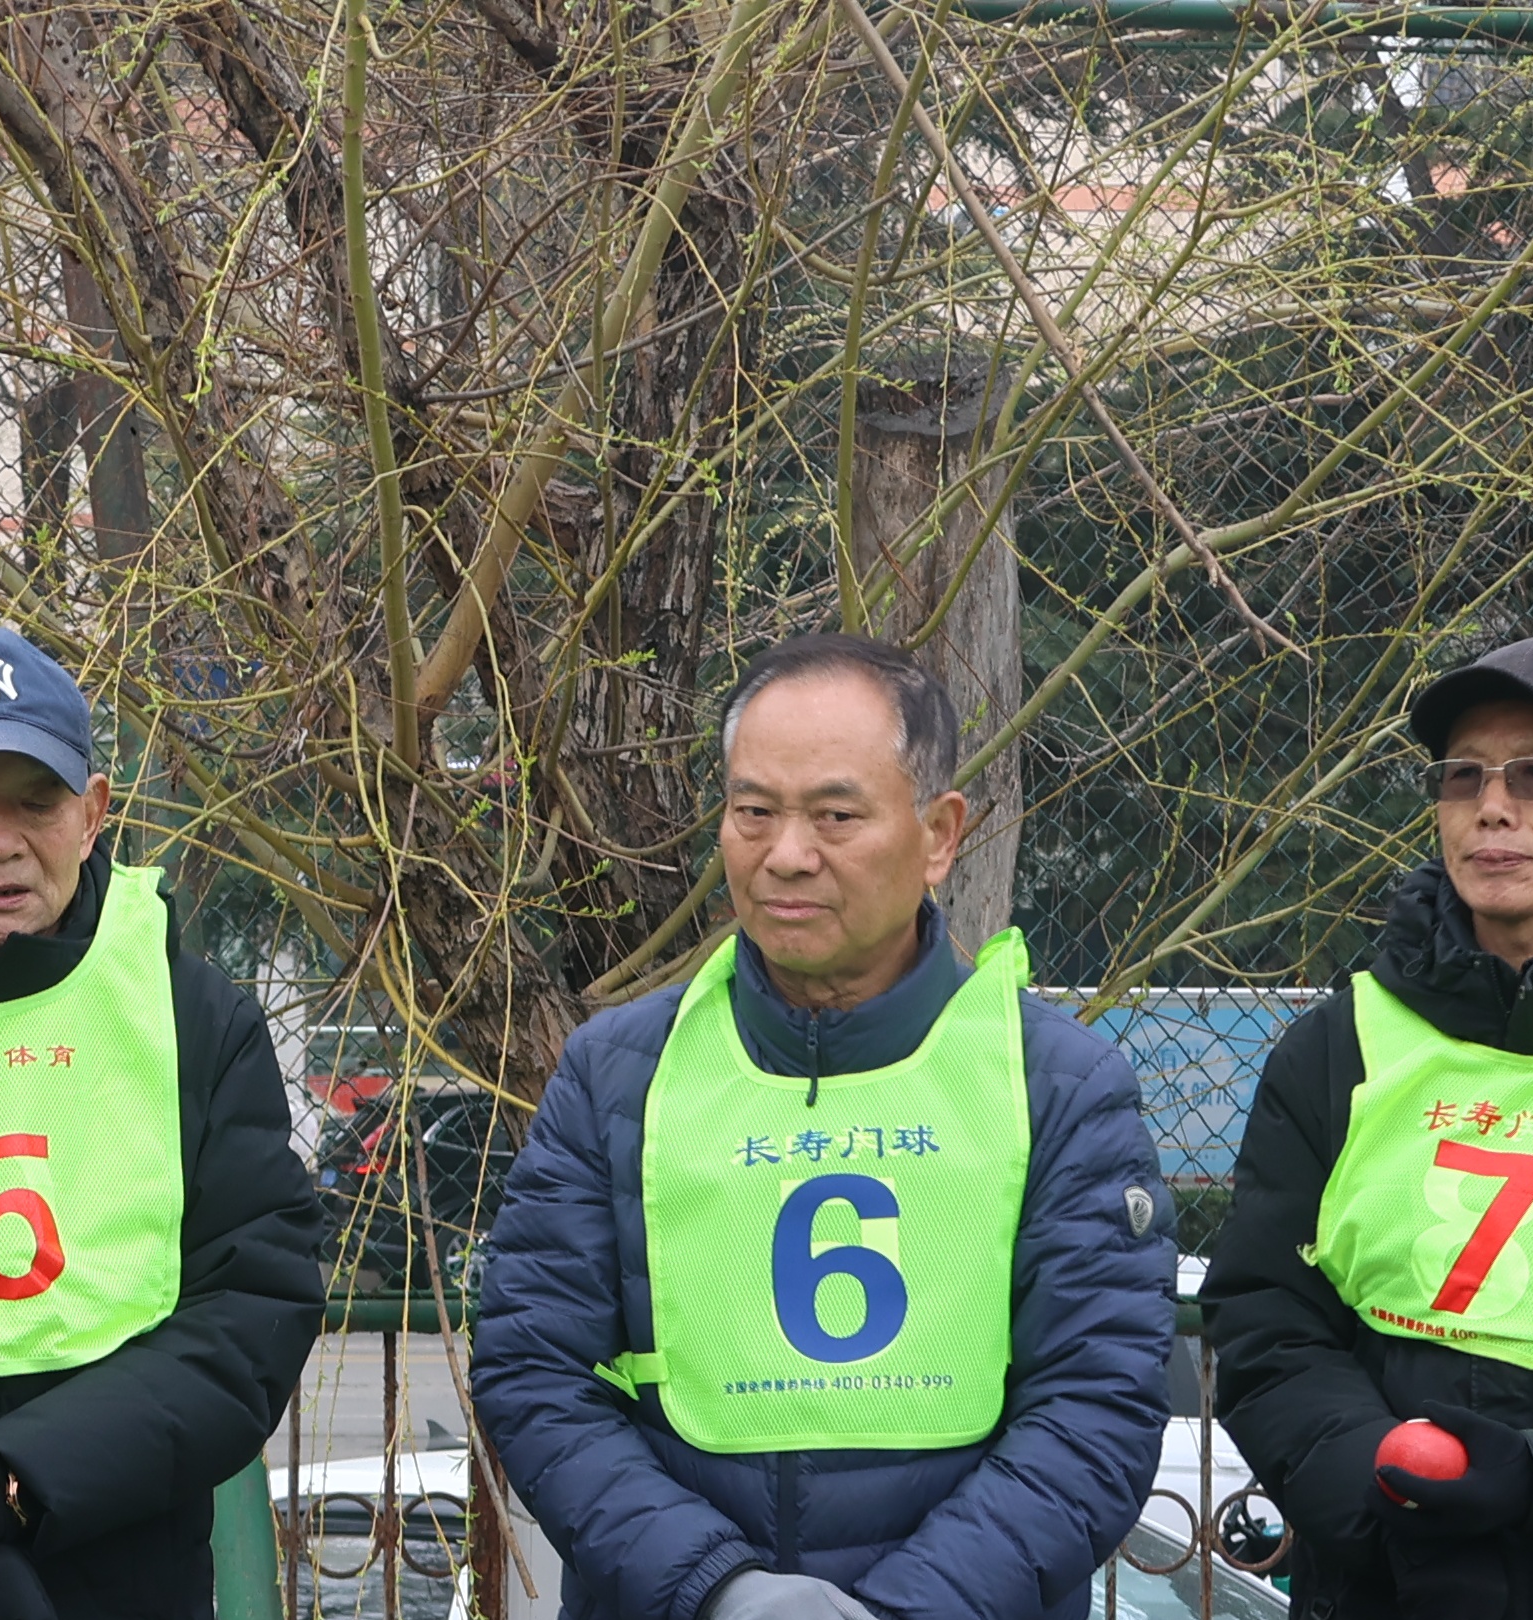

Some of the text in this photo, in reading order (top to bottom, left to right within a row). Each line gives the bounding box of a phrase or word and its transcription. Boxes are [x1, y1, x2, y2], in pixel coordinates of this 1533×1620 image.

[735, 1124, 940, 1166] 长寿门球
[771, 1173, 909, 1364] 6
[830, 1374, 954, 1391] 400-0340-999
